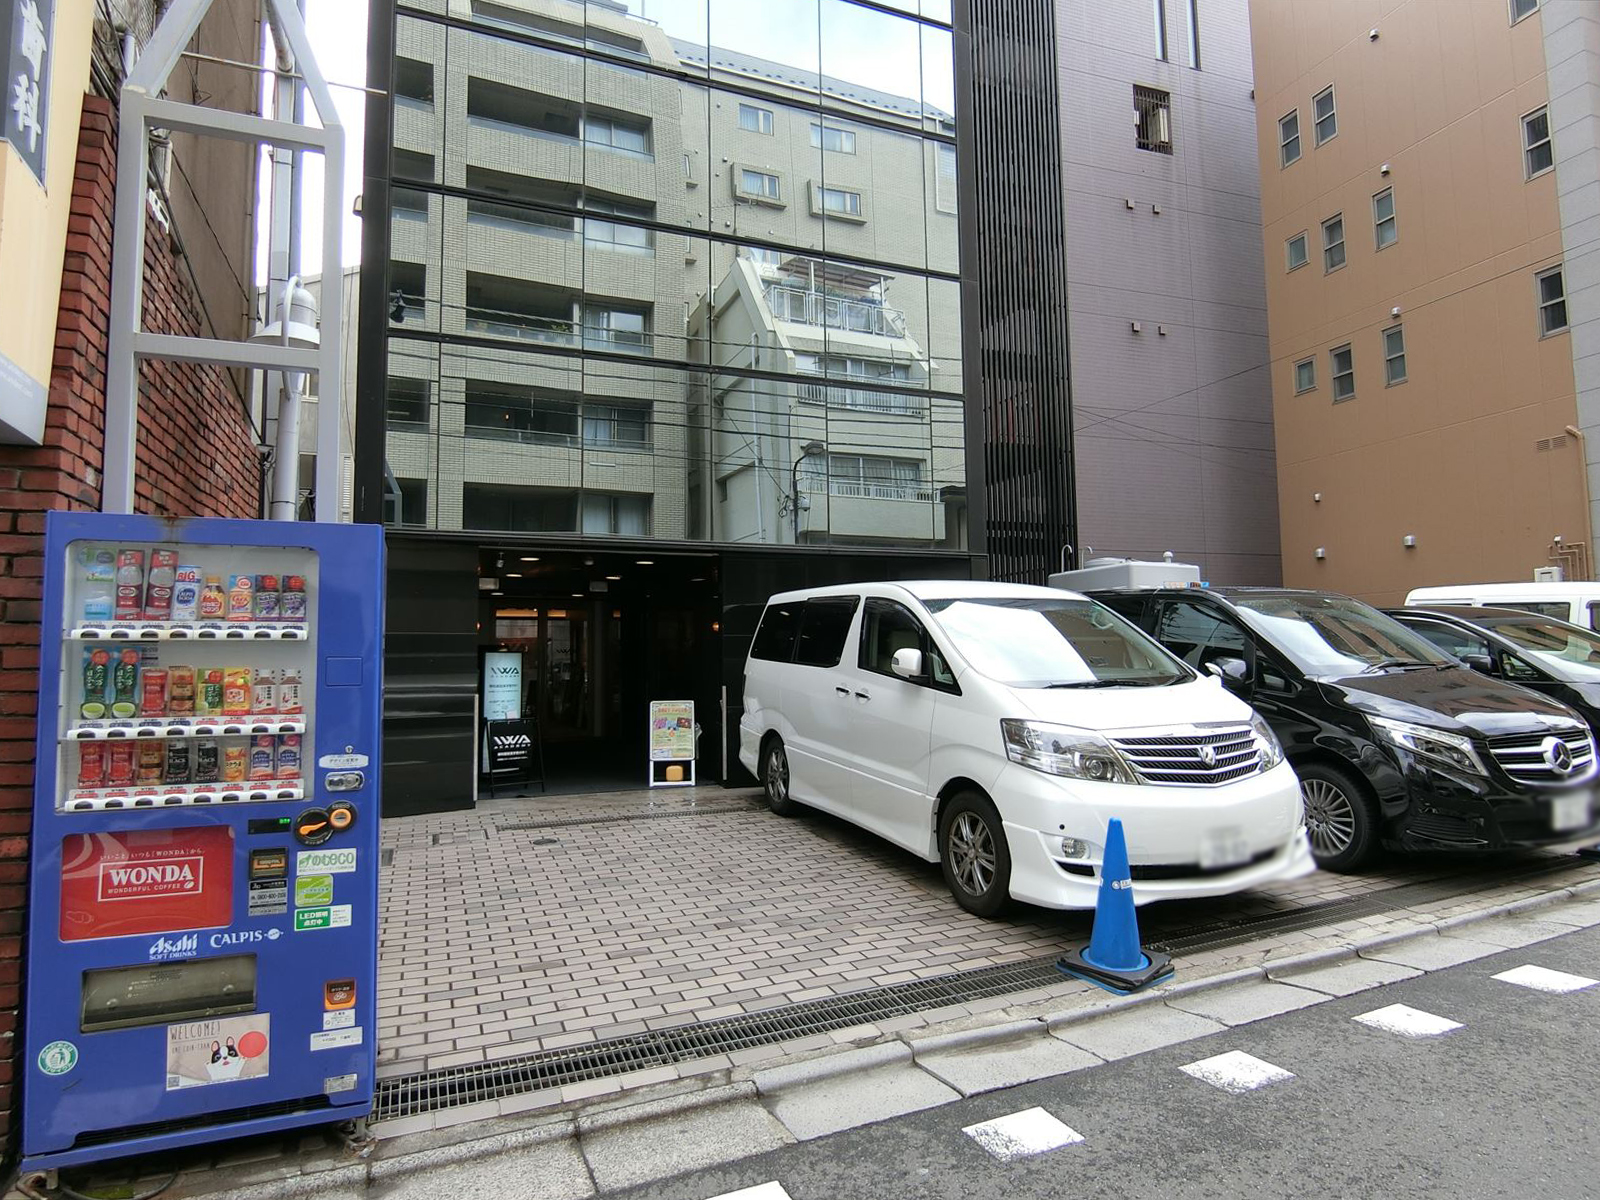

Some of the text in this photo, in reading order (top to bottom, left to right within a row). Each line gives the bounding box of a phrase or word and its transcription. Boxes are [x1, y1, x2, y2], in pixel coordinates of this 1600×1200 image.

[490, 666, 520, 675] IWA
[493, 734, 532, 745] IWA
[109, 863, 195, 887] WONDA
[107, 883, 181, 895] WONDERFUL COFFEE
[149, 933, 198, 955] Asahi
[210, 930, 263, 948] CALPIS
[149, 950, 198, 961] SOFT DRINKS
[169, 1021, 221, 1041] WELCOME!
